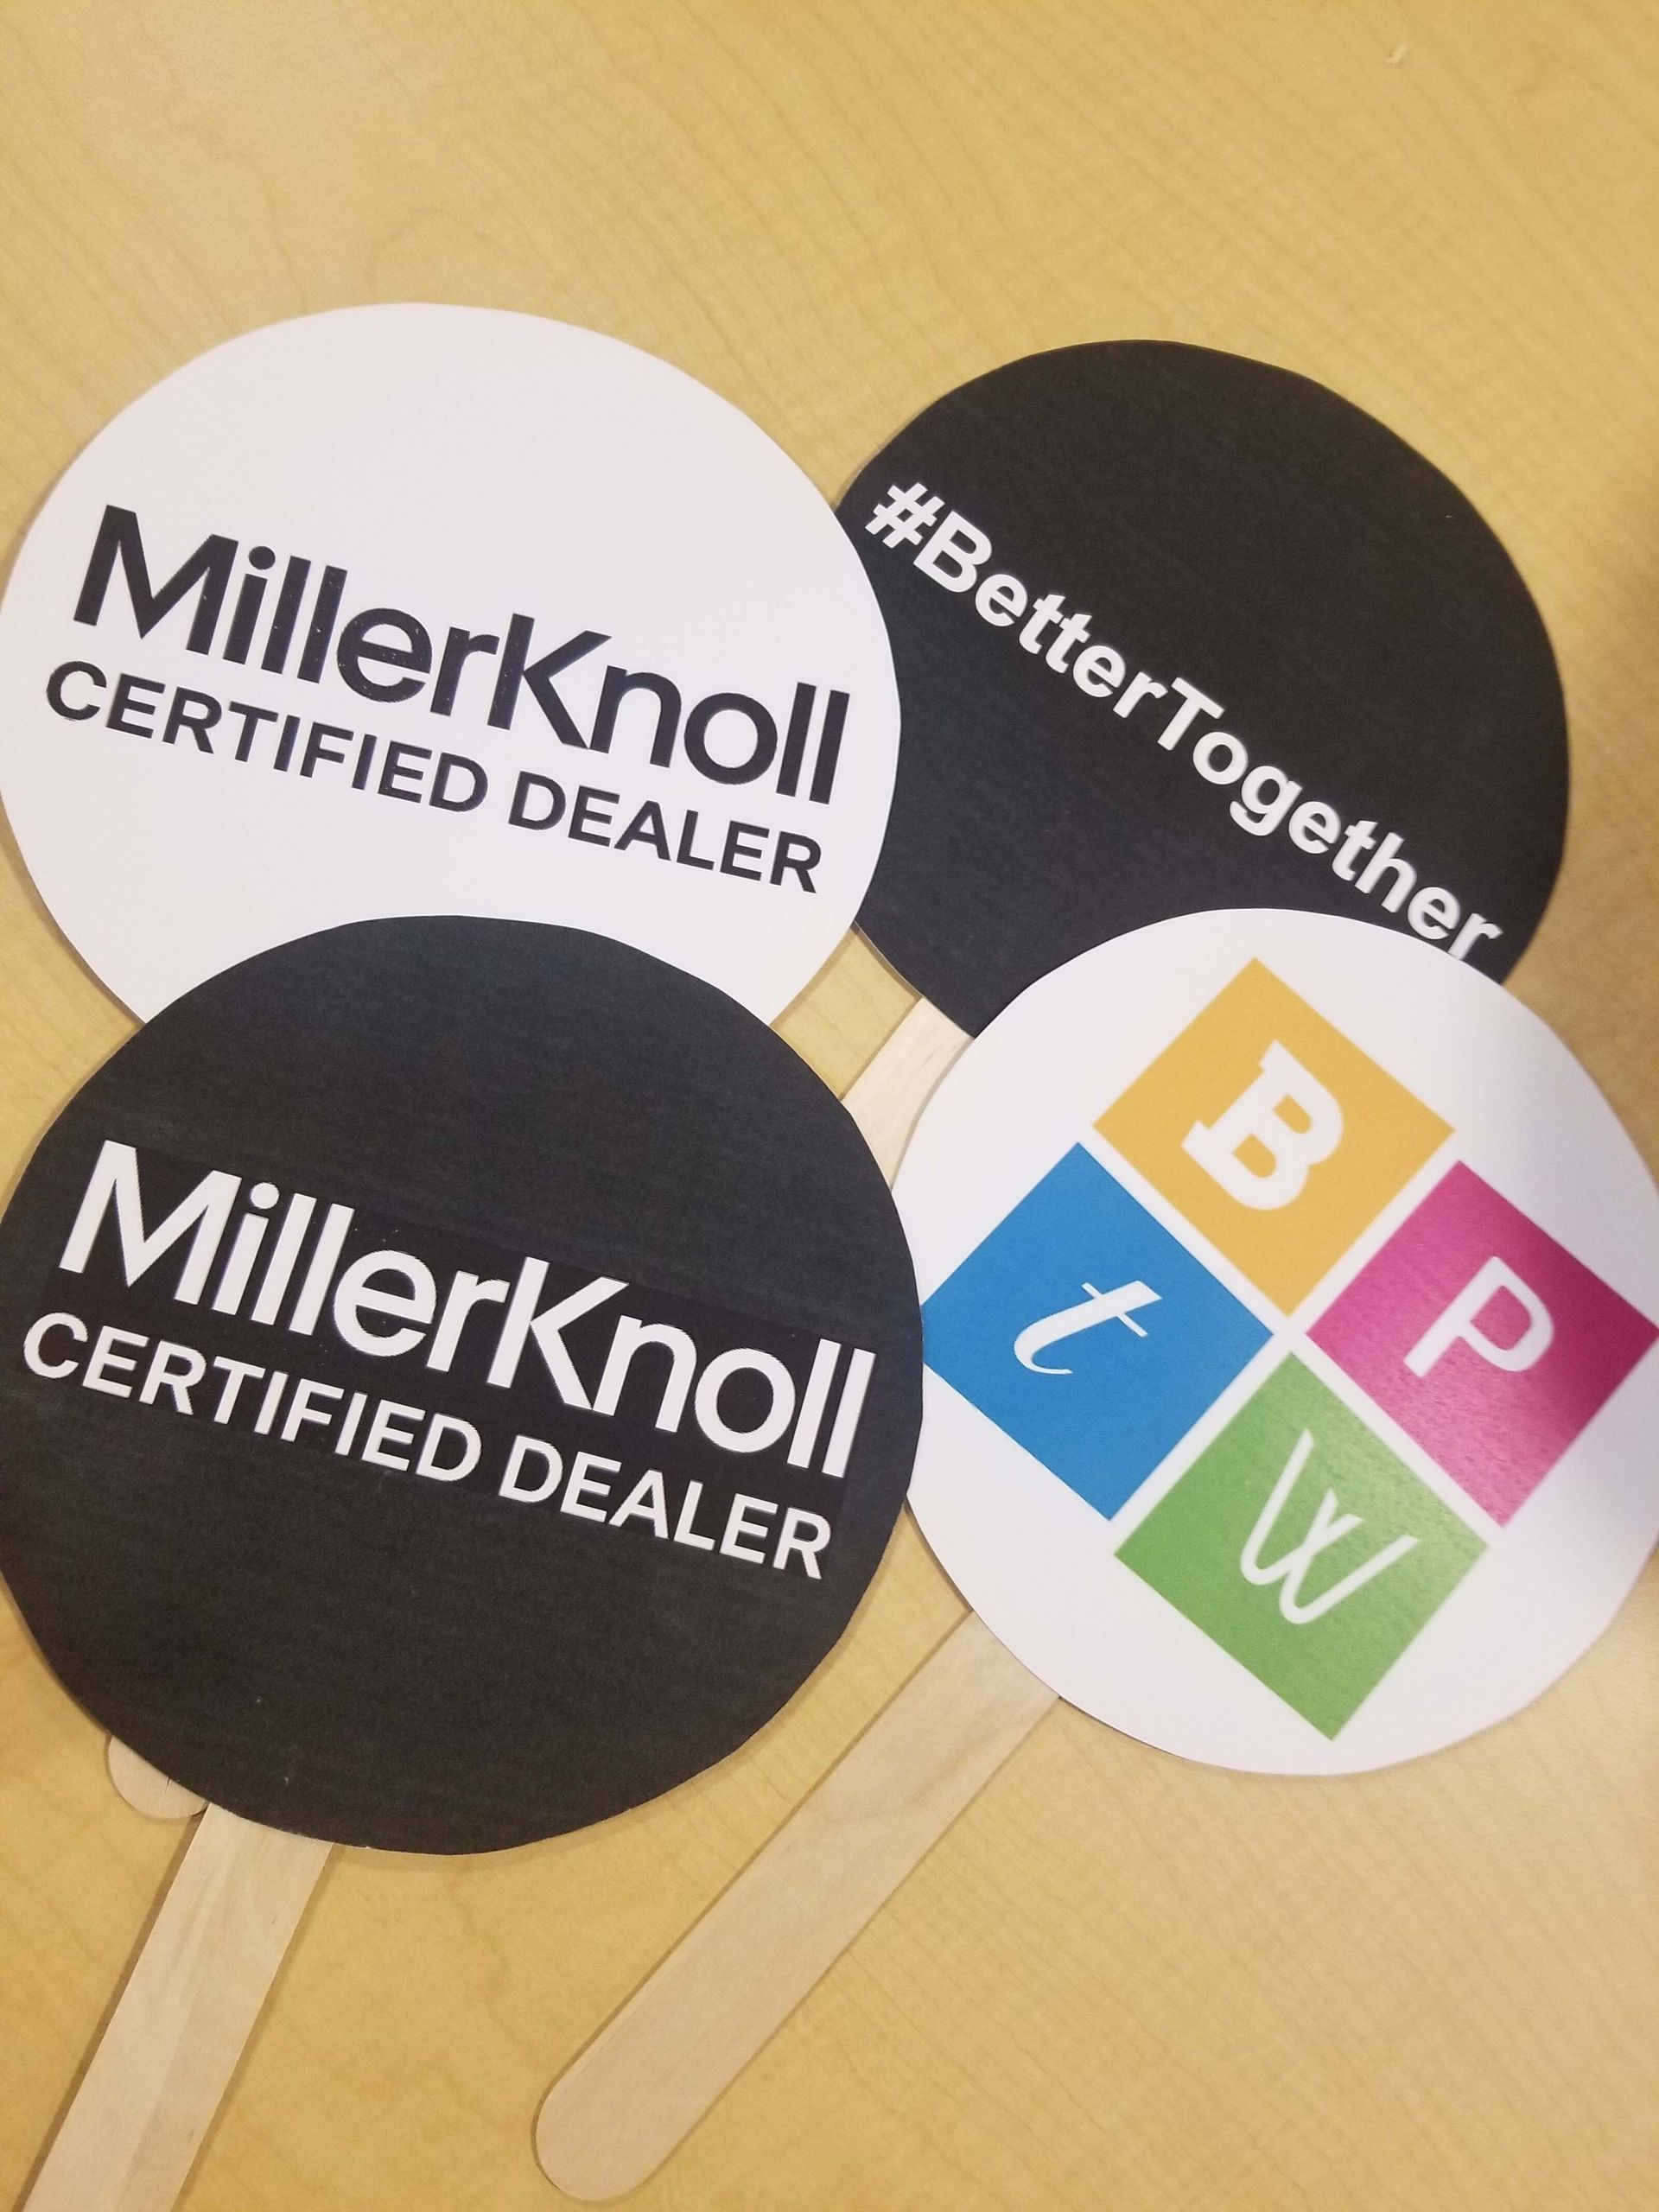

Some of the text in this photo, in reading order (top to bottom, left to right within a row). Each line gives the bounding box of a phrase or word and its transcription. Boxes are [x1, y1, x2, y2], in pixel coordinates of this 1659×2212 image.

[45, 660, 823, 893] CERTIFIED DEALER
[73, 504, 851, 805] MillerKnoll
[865, 482, 1503, 961] #BetterTogether
[58, 1140, 876, 1478] MillerKnoll
[1181, 1039, 1554, 1378] B P
[23, 1312, 831, 1580] CERTIFIED DEALER
[1014, 1280, 1420, 1625] t W
